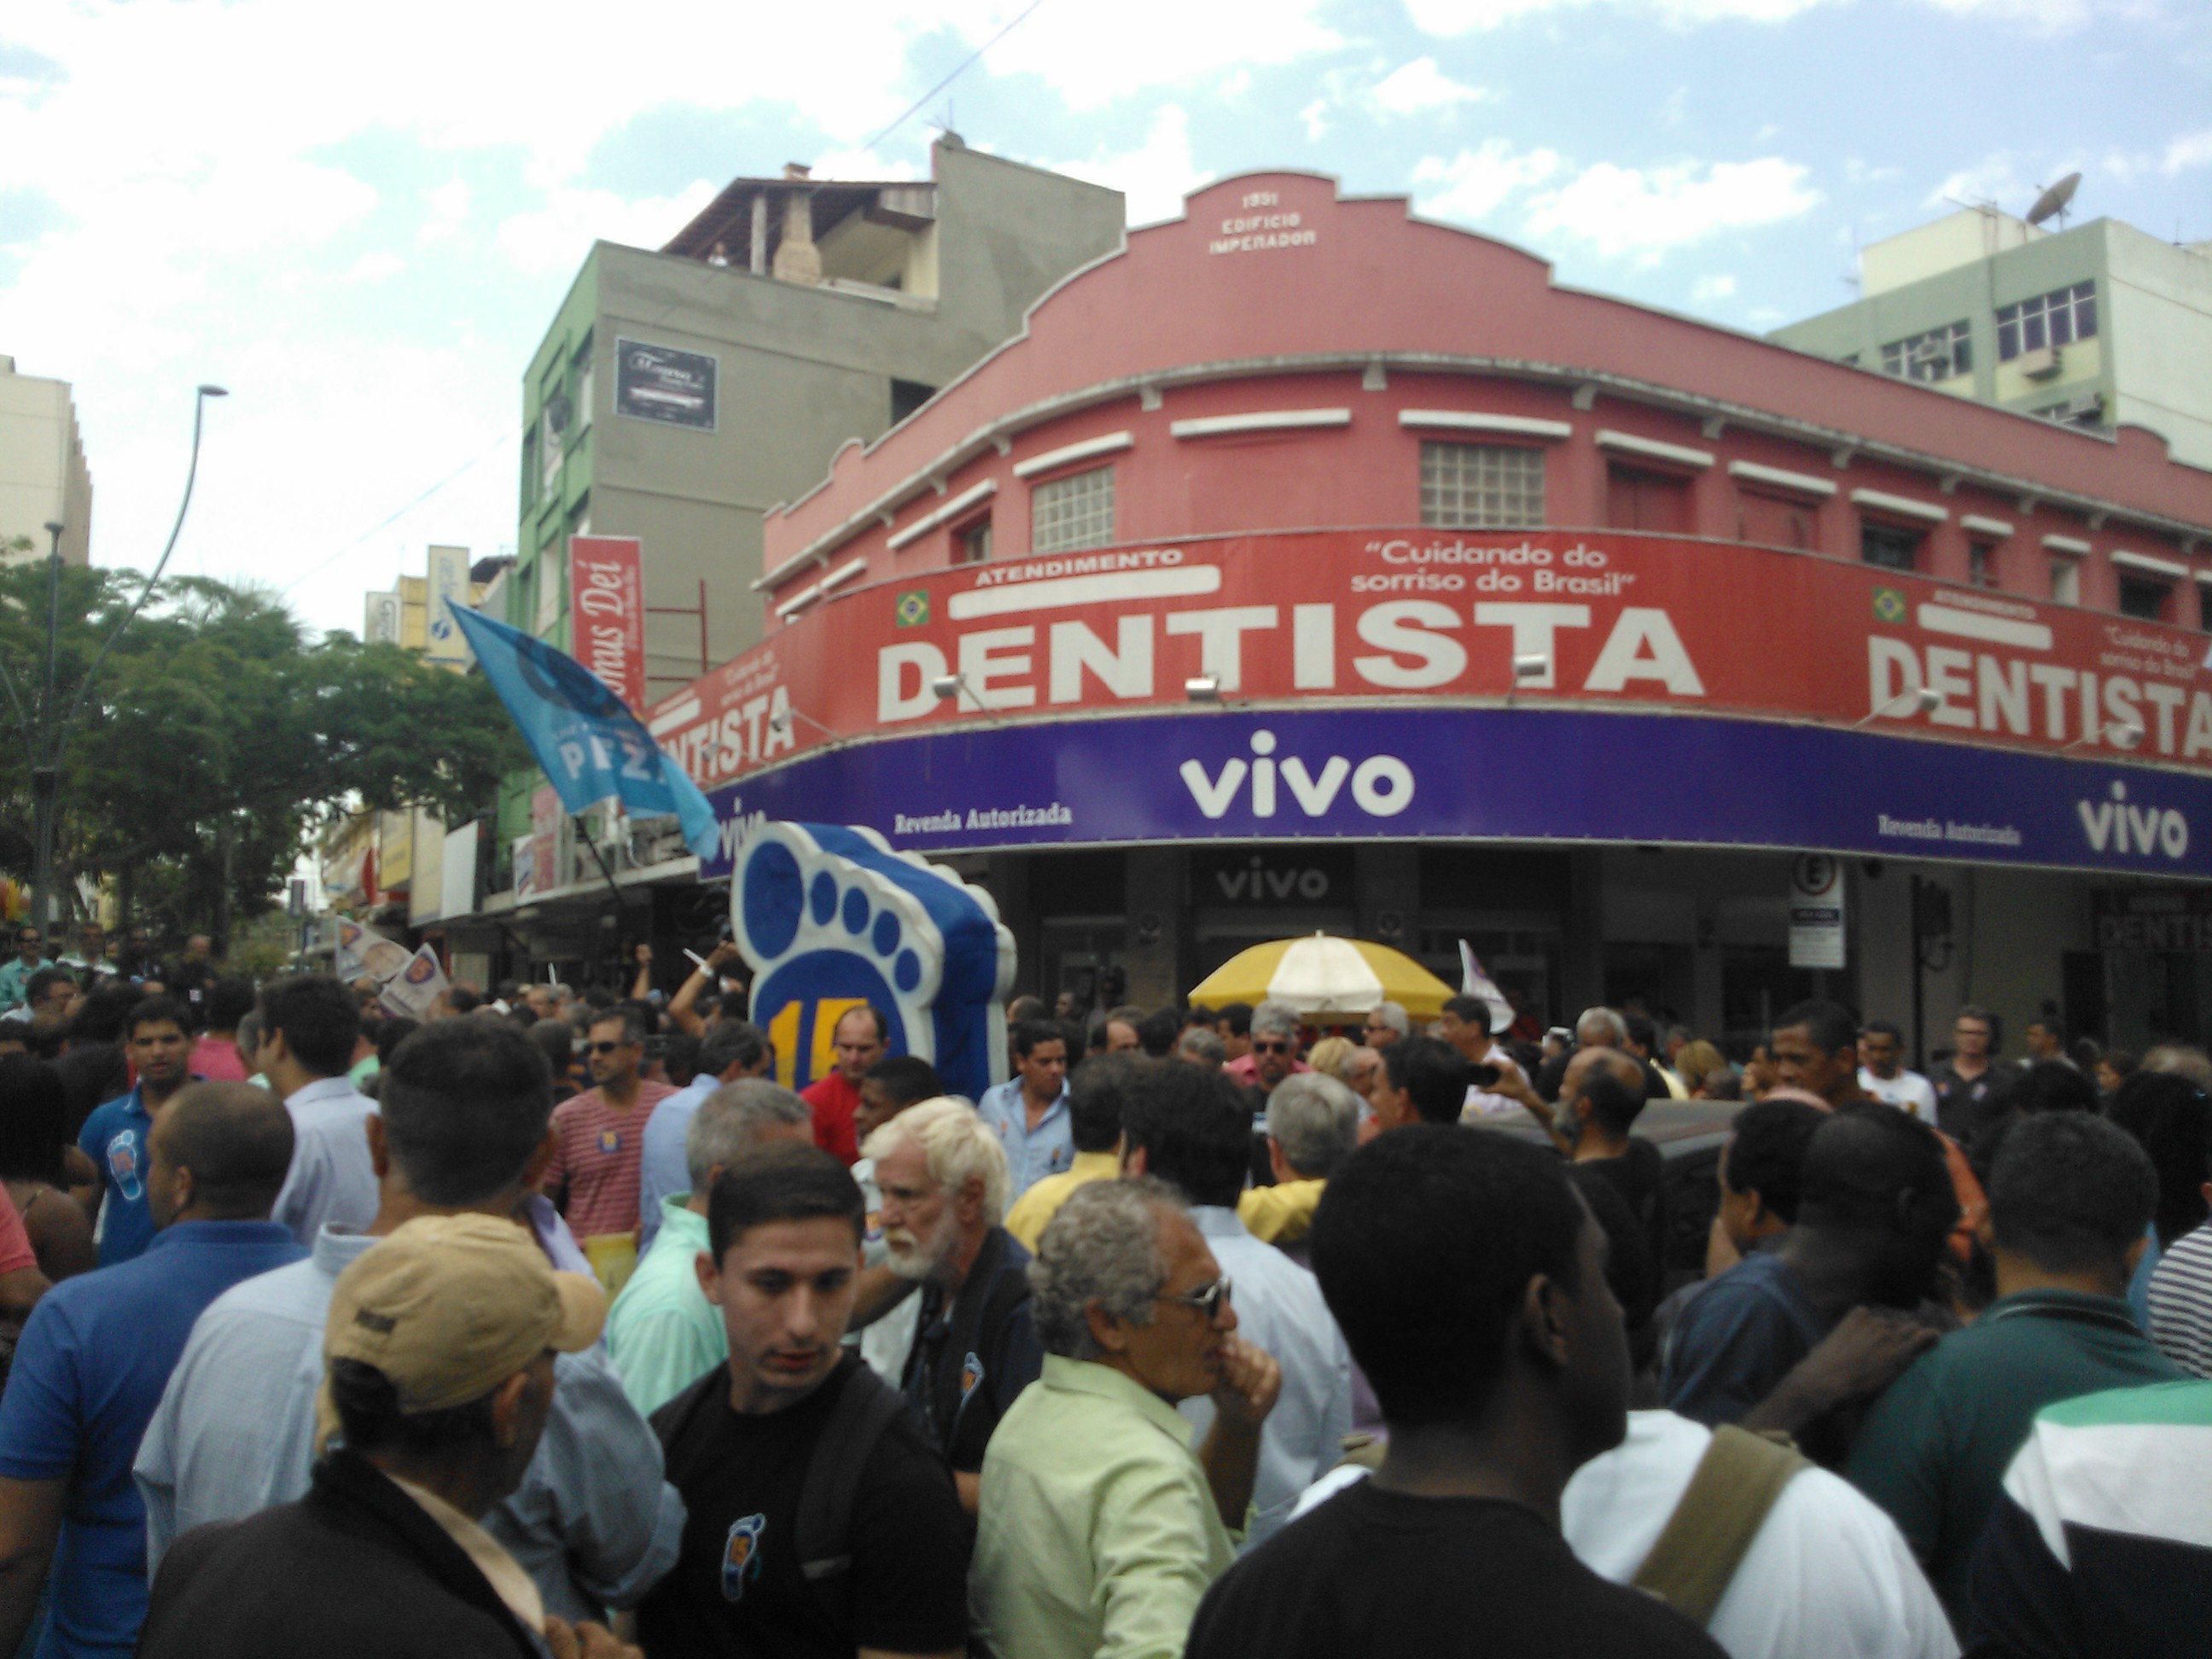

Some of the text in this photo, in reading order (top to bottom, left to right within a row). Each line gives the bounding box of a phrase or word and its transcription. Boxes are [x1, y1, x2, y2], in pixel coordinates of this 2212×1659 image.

[975, 549, 1184, 587] ATENDIMENTO
[1350, 568, 1465, 592] sorriso
[1476, 568, 1522, 591] do
[1563, 544, 1608, 568] do
[575, 559, 625, 618] Dei
[877, 600, 1706, 722] DENTISTA
[1868, 635, 2212, 758] DENTISTA
[665, 685, 795, 783] NTISTA
[1179, 729, 1415, 819] vivo
[719, 795, 766, 861] viv
[894, 801, 1073, 835] Revenda Autorizada
[2078, 780, 2189, 859] vivo
[1216, 855, 1329, 899] vivo
